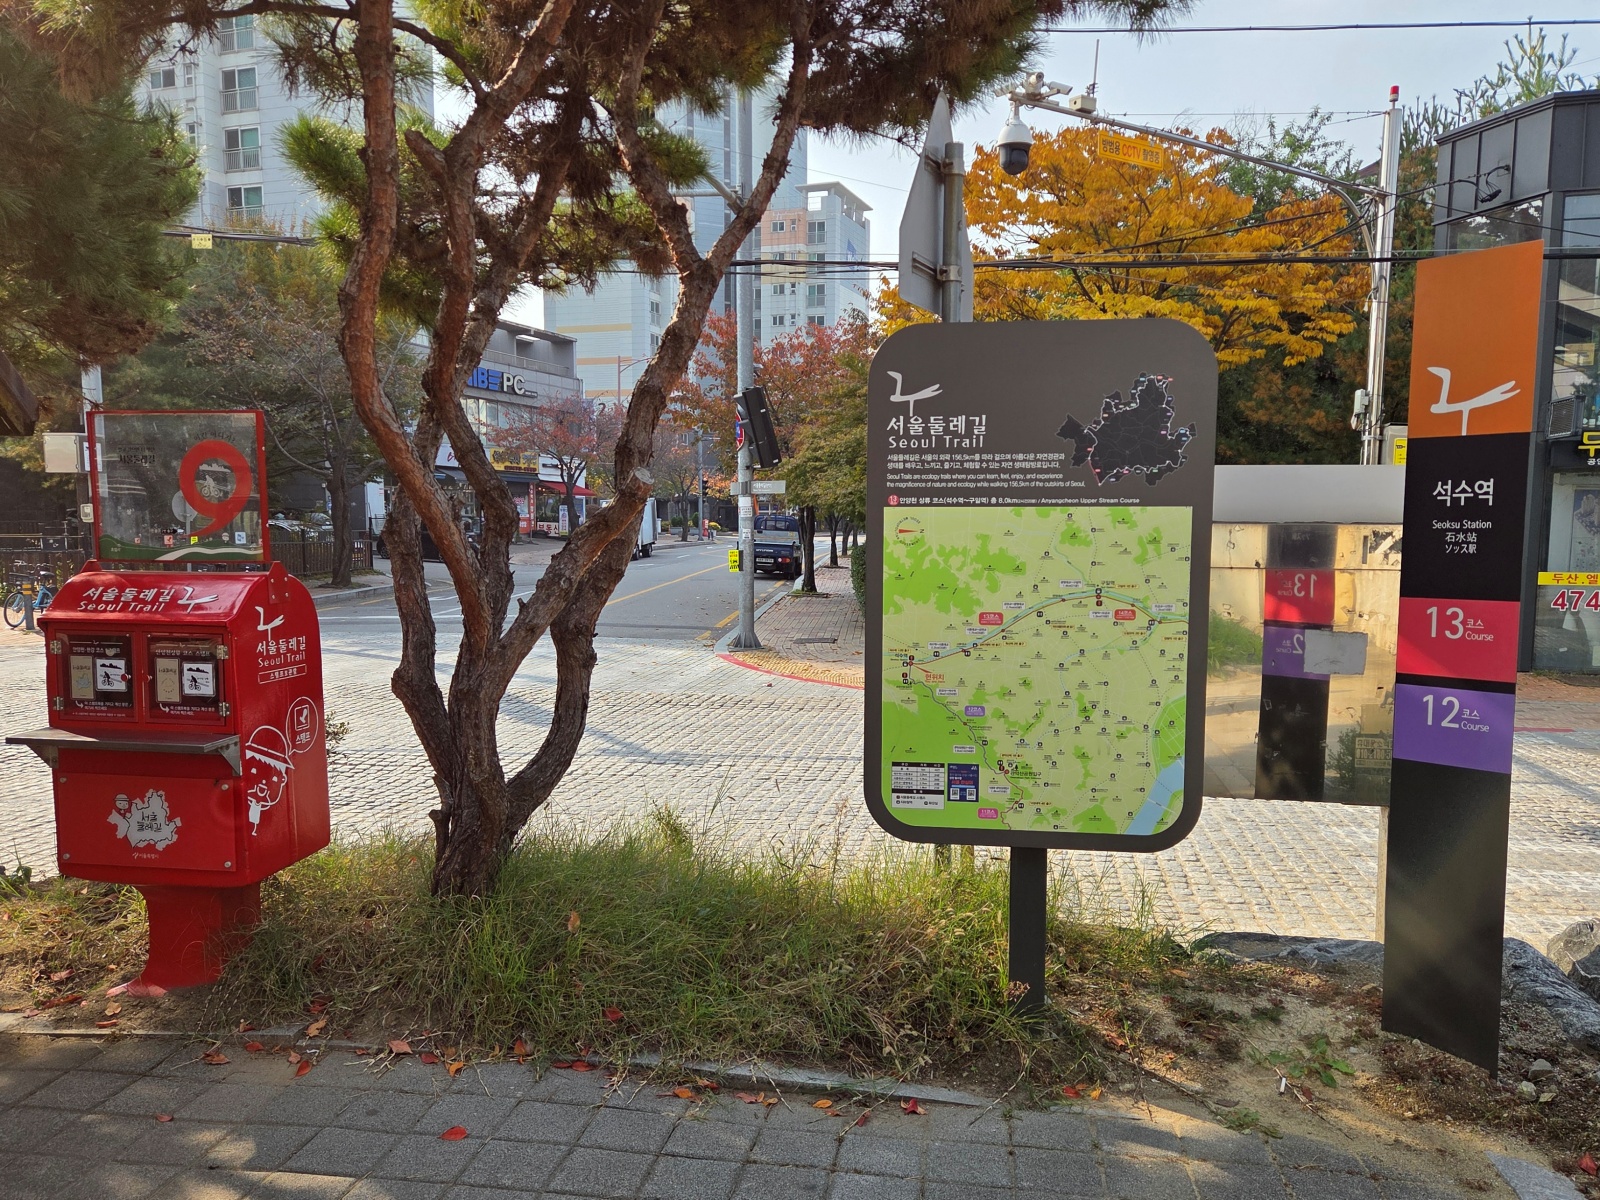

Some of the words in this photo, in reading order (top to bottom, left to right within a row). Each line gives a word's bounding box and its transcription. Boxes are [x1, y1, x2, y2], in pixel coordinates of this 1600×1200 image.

[1102, 138, 1120, 156] 방범용
[1122, 143, 1141, 160] CCTV
[503, 372, 525, 395] PC
[886, 414, 987, 436] 서울둘레길
[888, 435, 936, 448] Seoul
[943, 434, 984, 448] Trail
[886, 453, 920, 461] 서울둘레길은
[921, 453, 938, 461] 서울의
[939, 453, 951, 461] 외곽
[994, 453, 1011, 461] 걸으며
[1036, 452, 1065, 460] 자연경관과
[989, 461, 1000, 469] 있는
[1432, 477, 1495, 507] 석수역
[1041, 497, 1079, 505] Anyangcheon
[1432, 519, 1461, 529] Seoksu
[1462, 519, 1492, 529] Station
[1445, 532, 1478, 543] 石水站
[1445, 543, 1477, 554] ソッス駅
[83, 586, 175, 602] 서울둘레길
[77, 600, 124, 612] Seoul
[128, 602, 165, 612] Trail
[1426, 606, 1464, 640] 13
[1466, 618, 1485, 629] 코스
[1465, 630, 1494, 641] Course
[256, 636, 306, 656] 서울둘레길
[258, 655, 284, 667] Seoul
[286, 651, 306, 663] Trail
[925, 673, 945, 681] 현위치
[1422, 694, 1460, 729] 12
[1461, 708, 1480, 719] 코스
[1461, 720, 1490, 732] Course
[295, 731, 311, 744] 스탬프
[141, 811, 158, 822] 서울
[137, 821, 162, 833] 둘레길
